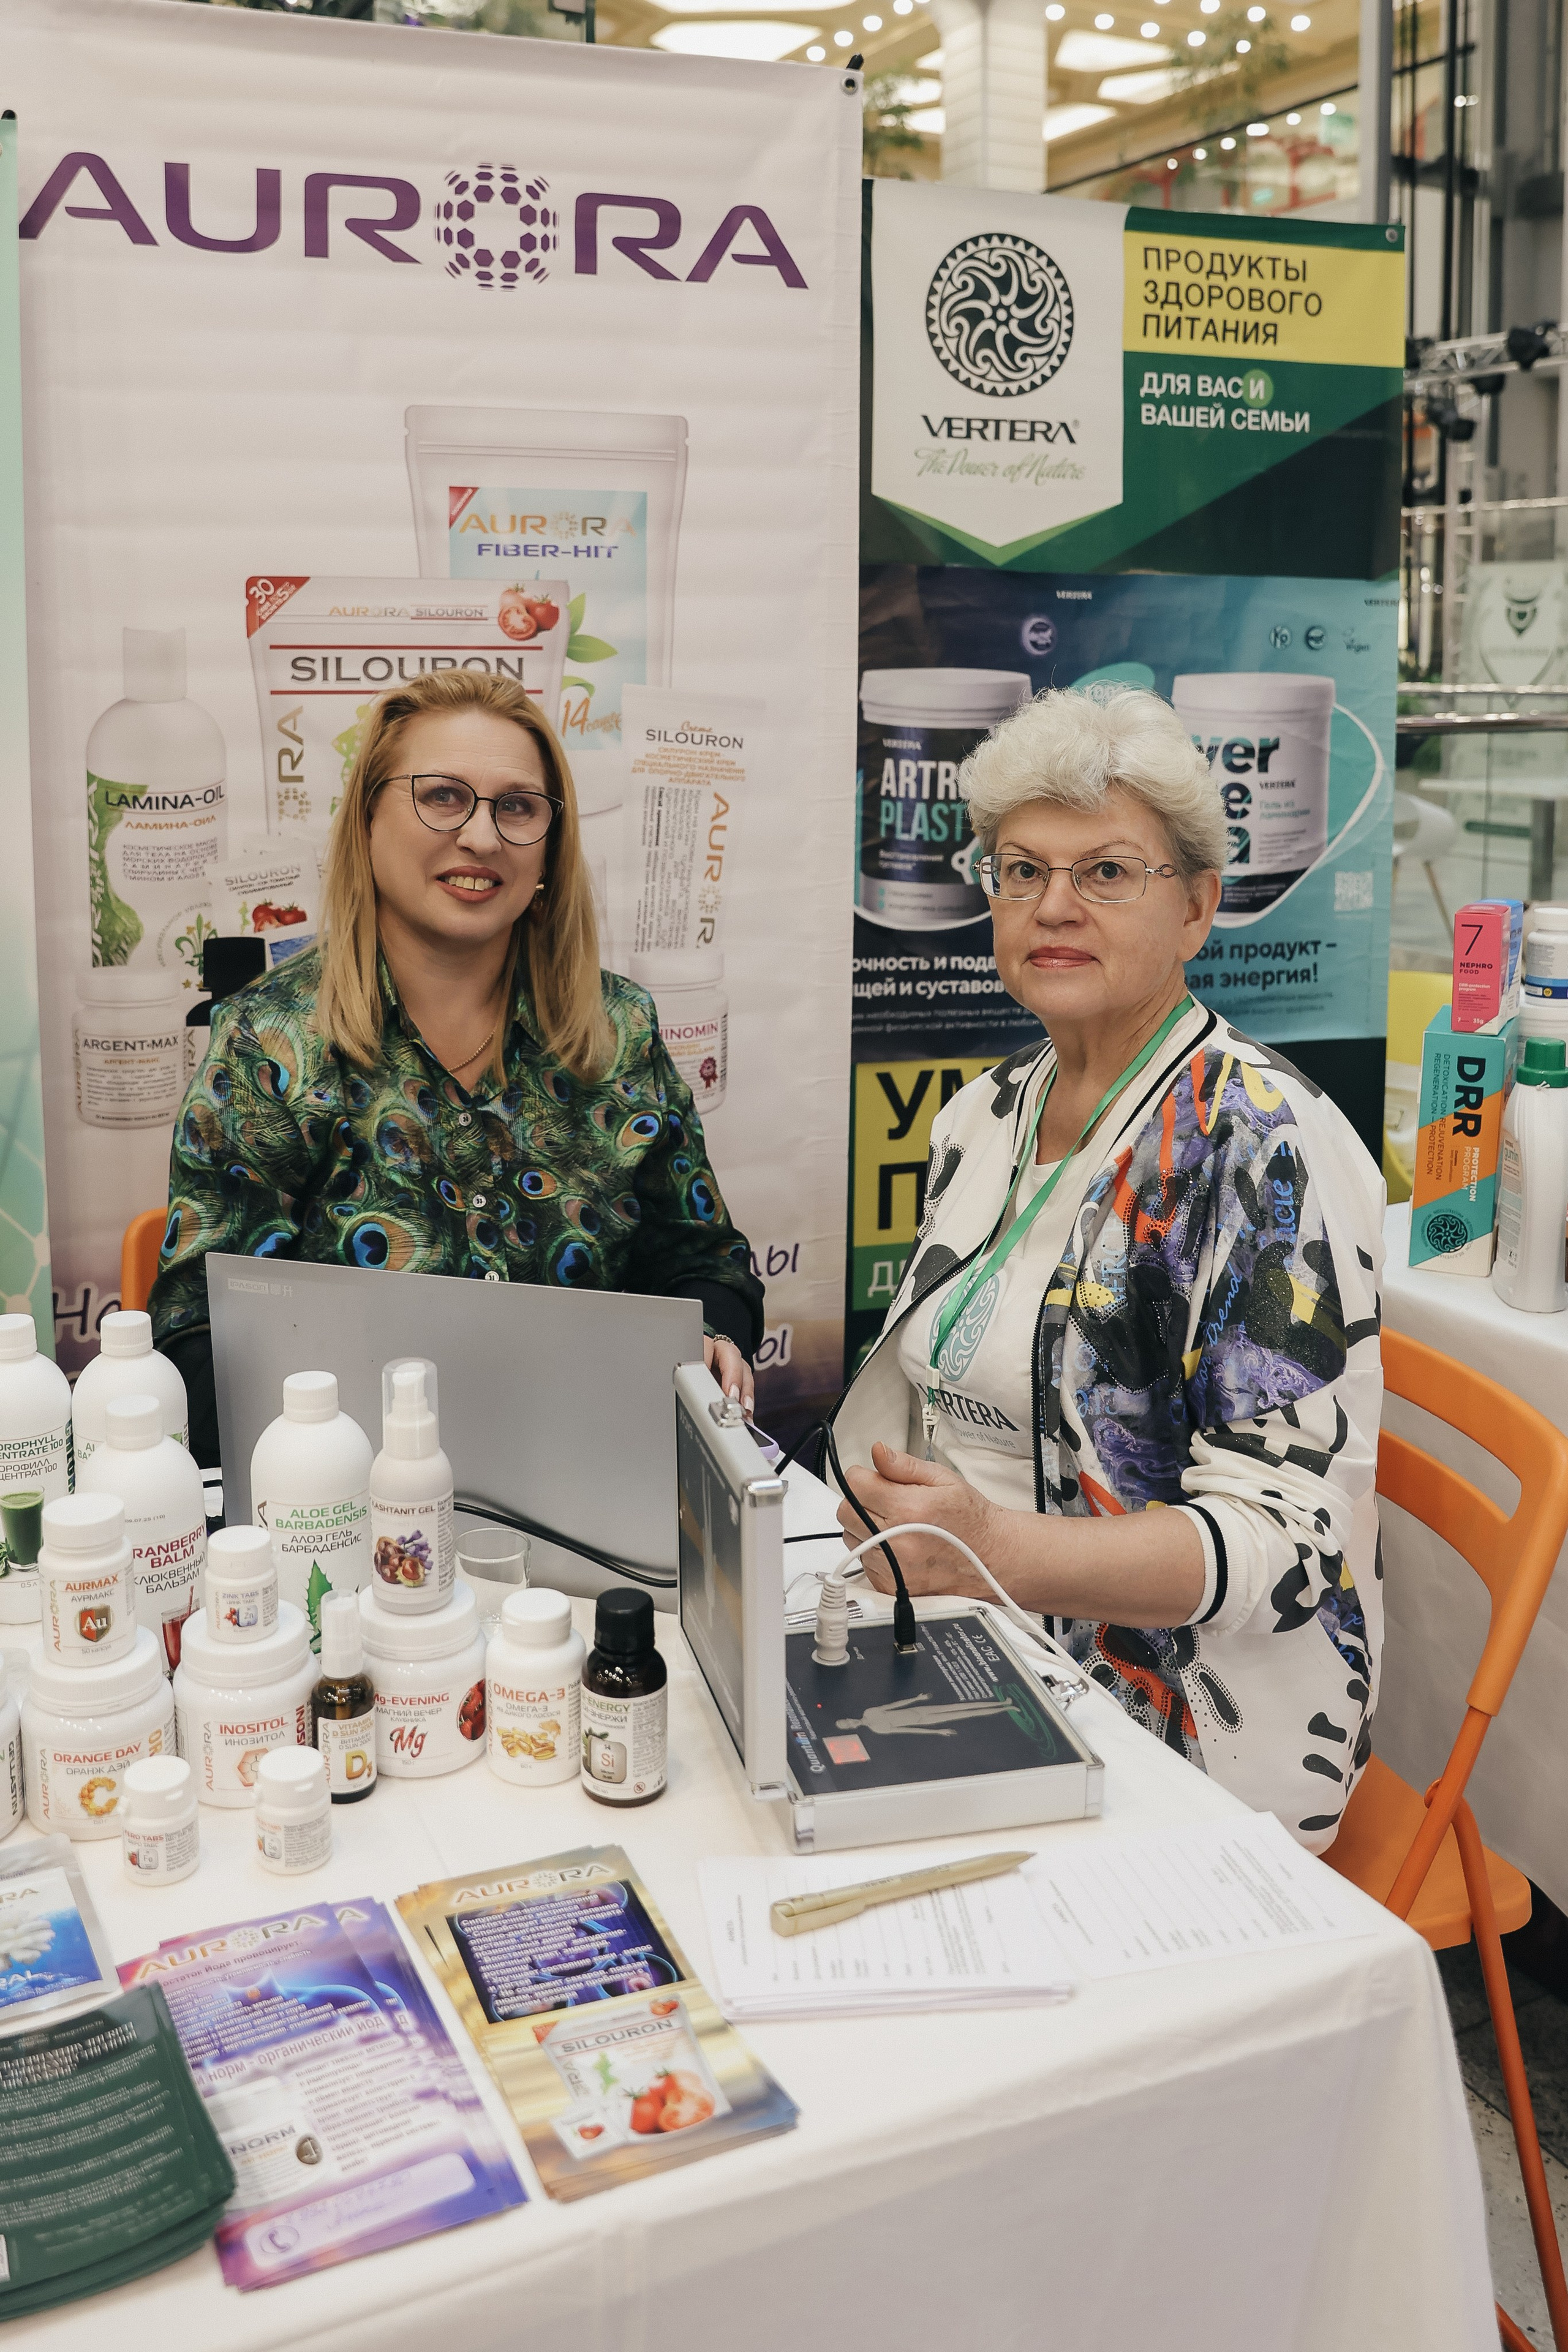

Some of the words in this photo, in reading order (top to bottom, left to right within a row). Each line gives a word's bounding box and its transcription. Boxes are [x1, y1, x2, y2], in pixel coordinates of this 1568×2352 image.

[18, 151, 810, 292] AURORA
[1143, 247, 1307, 283] ПРОДУКТЫ
[1144, 280, 1322, 317] ЗДОРОВОГО
[1143, 314, 1278, 345] ПИТАНИЯ
[1139, 371, 1191, 399] ДЛЯ
[1196, 375, 1243, 399] ВАС
[1248, 377, 1265, 400] И
[1140, 402, 1225, 429] ВАШЕЙ
[1231, 408, 1311, 434] СЕМЬИ
[478, 543, 619, 558] FIBER-HIT
[247, 575, 277, 606] 30
[415, 608, 483, 617] SILOURON
[680, 720, 713, 733] Creme
[646, 729, 744, 750] SILOURON
[105, 785, 225, 810] LAMINA-OIL
[879, 799, 967, 842] PLAST
[1461, 924, 1483, 956] 7
[933, 956, 947, 970] и
[1229, 940, 1322, 964] продукт
[899, 981, 913, 995] и
[1186, 973, 1215, 990] ая
[1219, 962, 1319, 991] энергия!
[1430, 1053, 1442, 1115] REGENERATION
[1439, 1054, 1451, 1115] DETOXICATION
[1451, 1055, 1487, 1137] DRR
[1426, 1125, 1436, 1175] PROTECTION
[1435, 1117, 1447, 1181] REJUVENATION
[1461, 1145, 1472, 1190] PROGRAM
[1468, 1147, 1480, 1202] PROTECTION
[50, 1438, 64, 1450] 100
[985, 1433, 1016, 1449] Nature
[45, 1463, 58, 1474] 100
[276, 1505, 368, 1530] BARBADENSIS
[290, 1507, 330, 1519] ALOE
[333, 1501, 357, 1514] GEL
[418, 1504, 435, 1514] GEL
[282, 1532, 363, 1554] БАРБАДЕНСИС
[291, 1534, 323, 1544] АЛОЭ
[325, 1529, 353, 1542] ГЕЛЬ
[150, 1544, 195, 1569] BALM
[65, 1574, 119, 1593] AURMAX
[146, 1568, 200, 1594] БАЛЬЗАМ
[71, 1589, 116, 1604] АУРМАКС
[83, 1613, 109, 1631] Au
[493, 1683, 566, 1703] OMEGA-3
[375, 1706, 412, 1717] МАГНИЙ
[413, 1707, 442, 1716] ВЕЧЕР
[505, 1702, 548, 1713] ОМЕГА-3
[219, 1716, 290, 1735] INOSITOL
[225, 1730, 285, 1746] ИНОЗИТОЛ
[53, 1751, 113, 1764] ORANGE
[115, 1741, 142, 1758] DAY
[601, 1753, 615, 1768] Si
[66, 1766, 105, 1776] ОРАНЖ
[107, 1760, 131, 1773] ДЭЙ
[460, 1912, 504, 1927] Силурон
[560, 2019, 674, 2054] SILOURON
[208, 2059, 247, 2082] норм
[257, 2022, 354, 2067] органический
